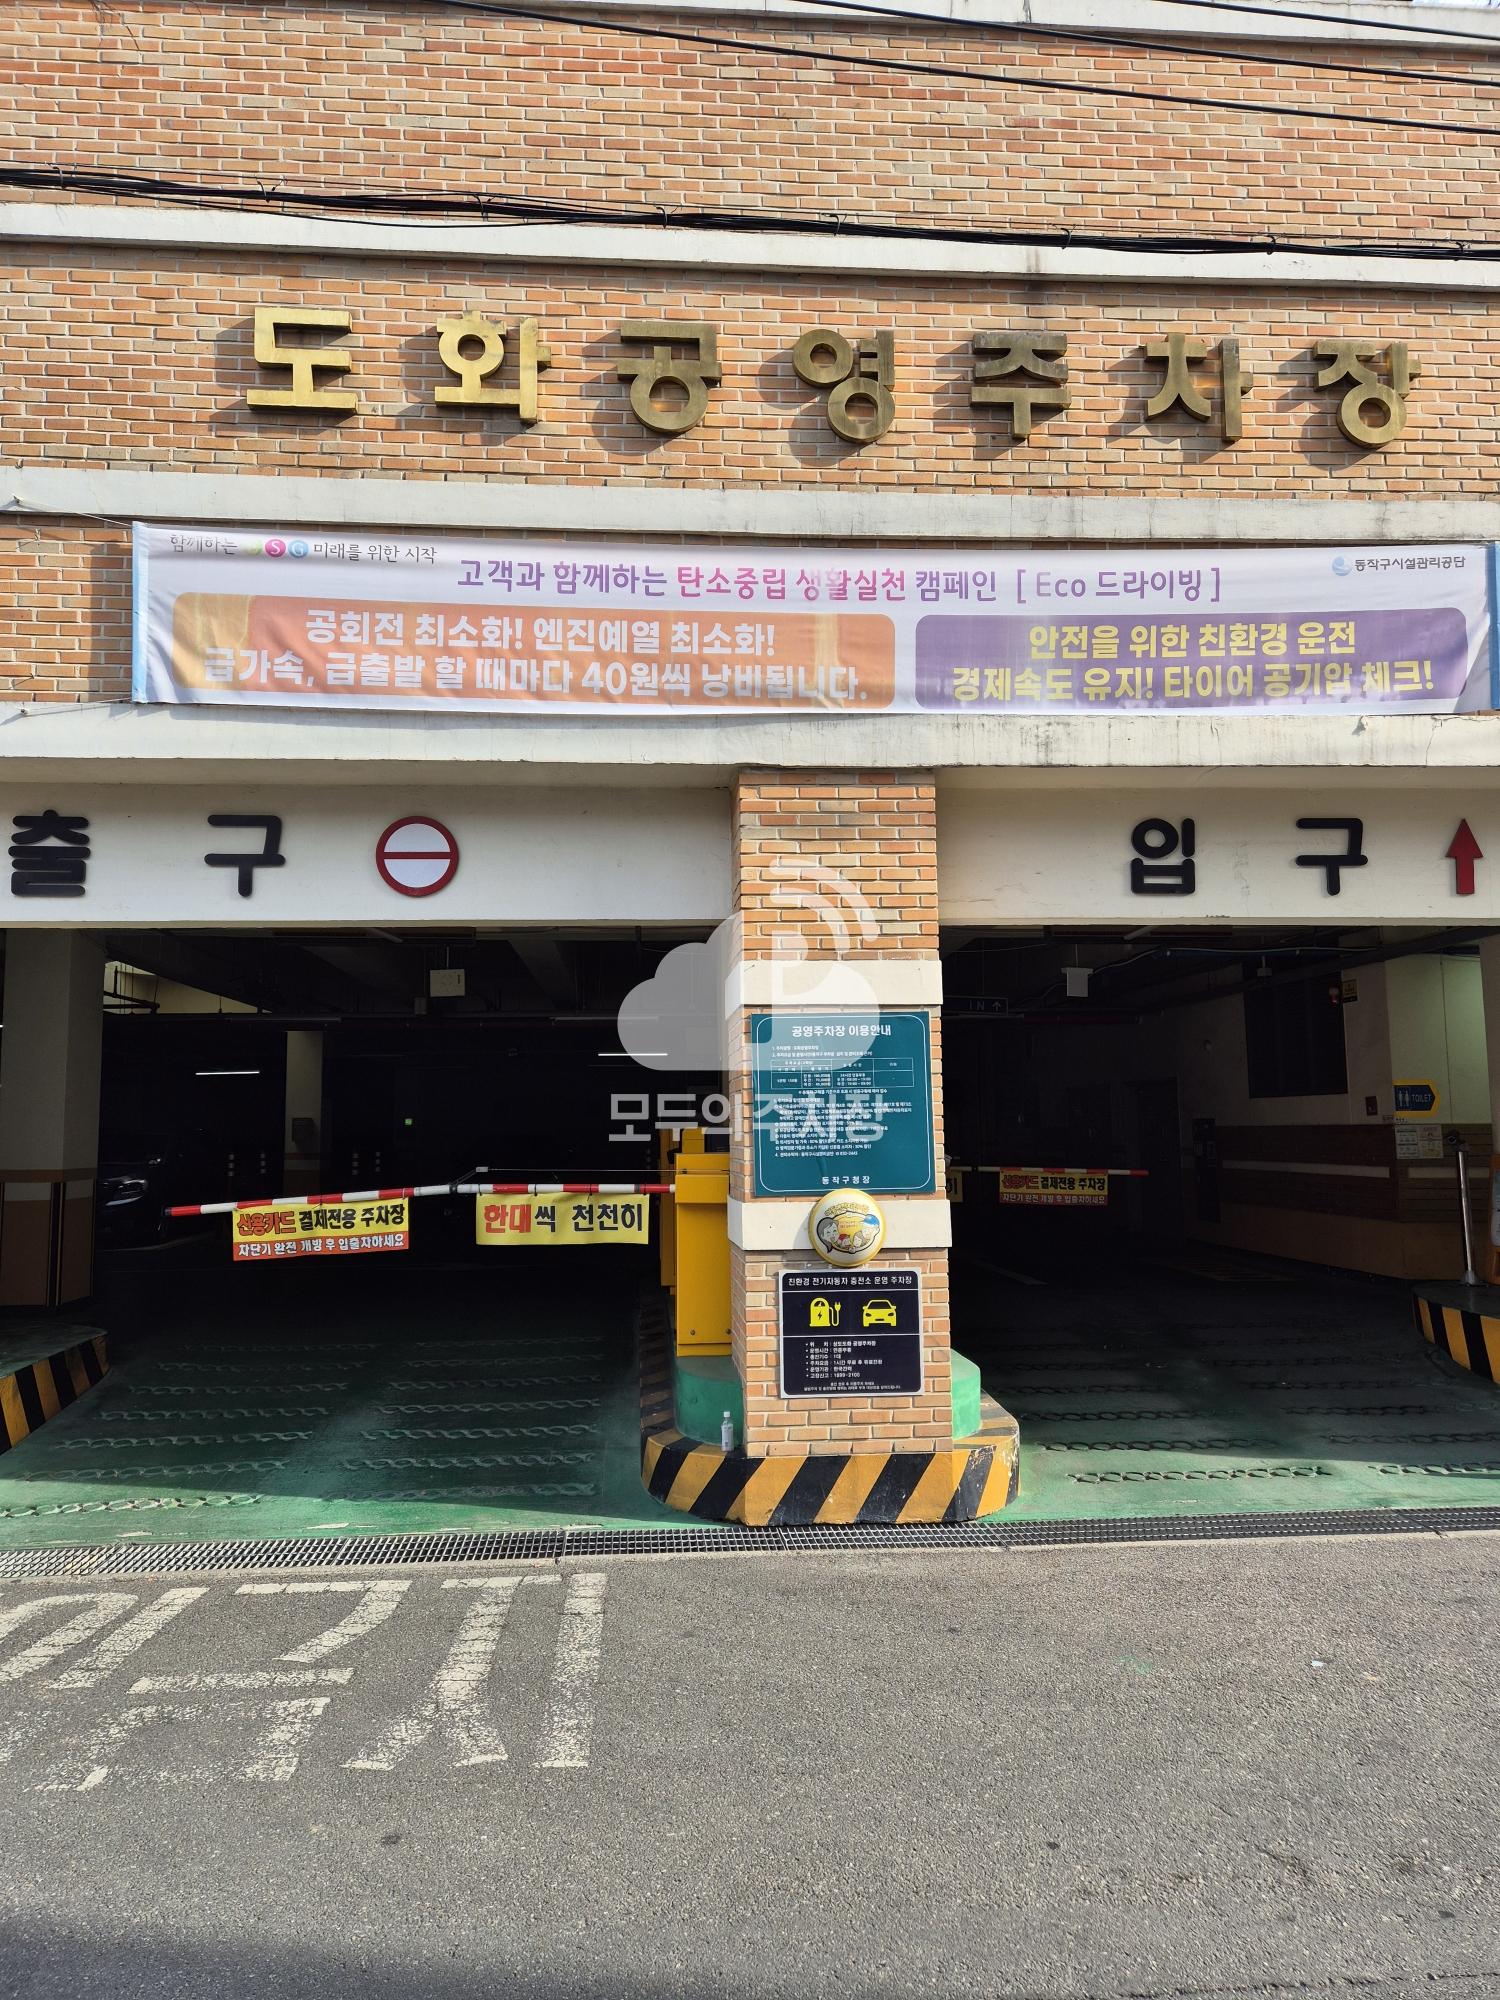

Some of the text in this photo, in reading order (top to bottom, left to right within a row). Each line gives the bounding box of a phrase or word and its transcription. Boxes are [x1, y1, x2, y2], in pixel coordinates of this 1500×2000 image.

[170, 534, 238, 555] 함께하는
[313, 543, 362, 562] 미래를
[367, 544, 400, 563] 위한
[405, 546, 437, 564] 시작
[1354, 555, 1466, 572] 동작구시설관리공단
[457, 560, 545, 592] 고객과
[552, 561, 668, 597] 함께하는
[677, 565, 786, 600] 탄소중립
[796, 567, 906, 602] 생활실천
[915, 570, 997, 601] 캠페인
[305, 609, 775, 656] 공회전 최소화! 엔진예열 최소화!
[1029, 620, 1356, 660] 안전을 위한 친환경 운전
[204, 647, 867, 700] 급가속, 급출발 할 때마다 40원씩 낭비됩니다.
[952, 659, 1434, 701] 경제속도 유지! 타이어 공기압 체크!
[969, 1000, 985, 1011] IN
[792, 1024, 892, 1038] 공영주차장 이용안내
[1411, 1093, 1432, 1103] TOILET
[237, 1203, 405, 1236] 신용카드 결제전용 주차장
[572, 1202, 643, 1233] 천천히
[238, 1233, 404, 1257] 차단기 완전 개방 후 입출차하세요
[788, 1276, 912, 1287] 친환경 전기자동차 충전소 운영 주차장
